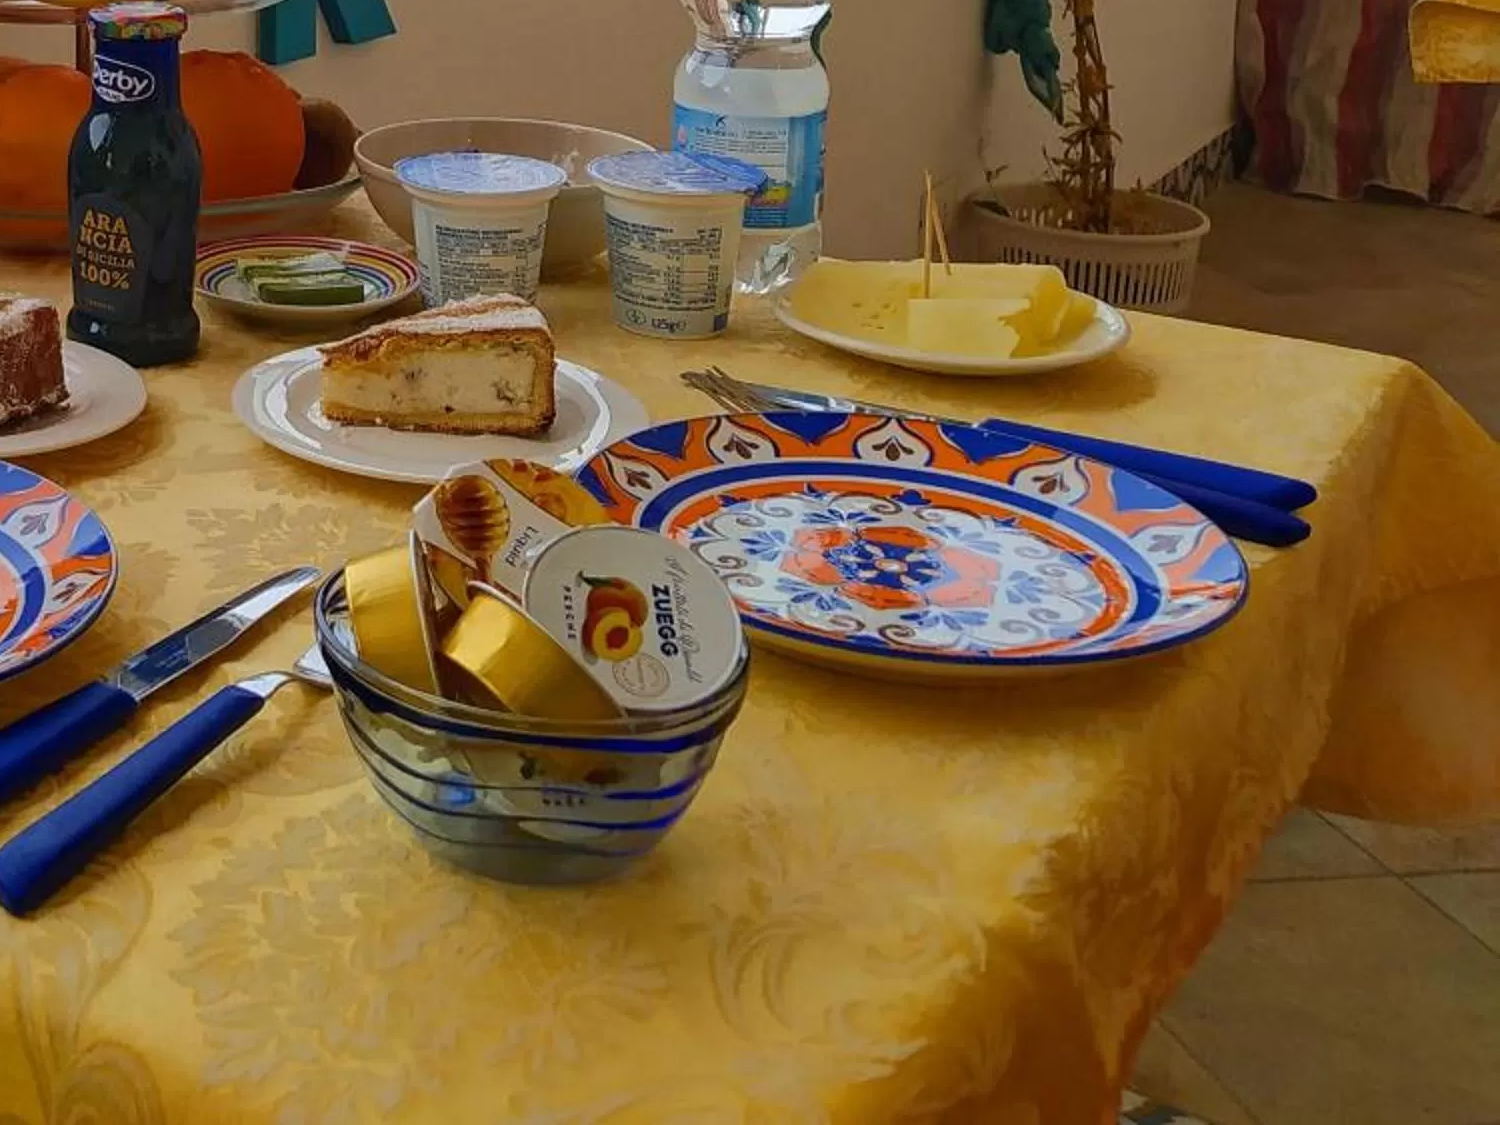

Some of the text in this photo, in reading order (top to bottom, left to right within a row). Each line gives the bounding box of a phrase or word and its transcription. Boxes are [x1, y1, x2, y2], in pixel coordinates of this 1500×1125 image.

[83, 208, 128, 234] ARA
[81, 261, 132, 290] 100%
[651, 583, 679, 658] ZUEGG
